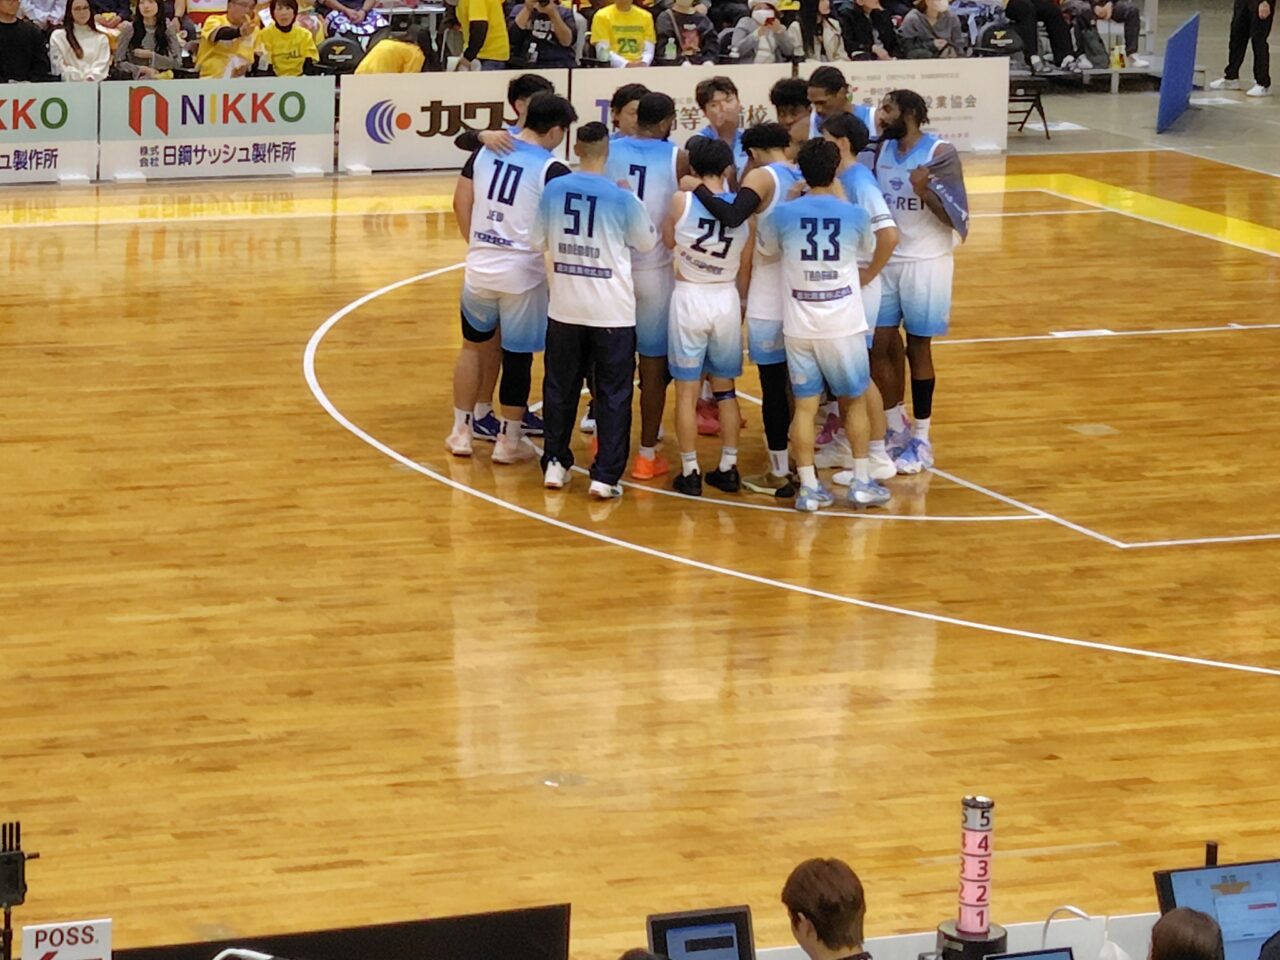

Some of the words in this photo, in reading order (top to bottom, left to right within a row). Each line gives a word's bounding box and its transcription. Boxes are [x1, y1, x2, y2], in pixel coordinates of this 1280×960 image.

[181, 90, 306, 126] NIKKO
[416, 100, 518, 138] カワ
[163, 141, 296, 166] 日鋼サッシュ製作所
[487, 159, 523, 206] 10
[629, 164, 647, 201] 7
[564, 192, 597, 237] 51
[800, 217, 841, 261] 33
[979, 809, 991, 828] 5
[977, 834, 989, 852] 4
[977, 860, 988, 878] 3
[975, 885, 987, 902] 2
[975, 910, 985, 928] 1
